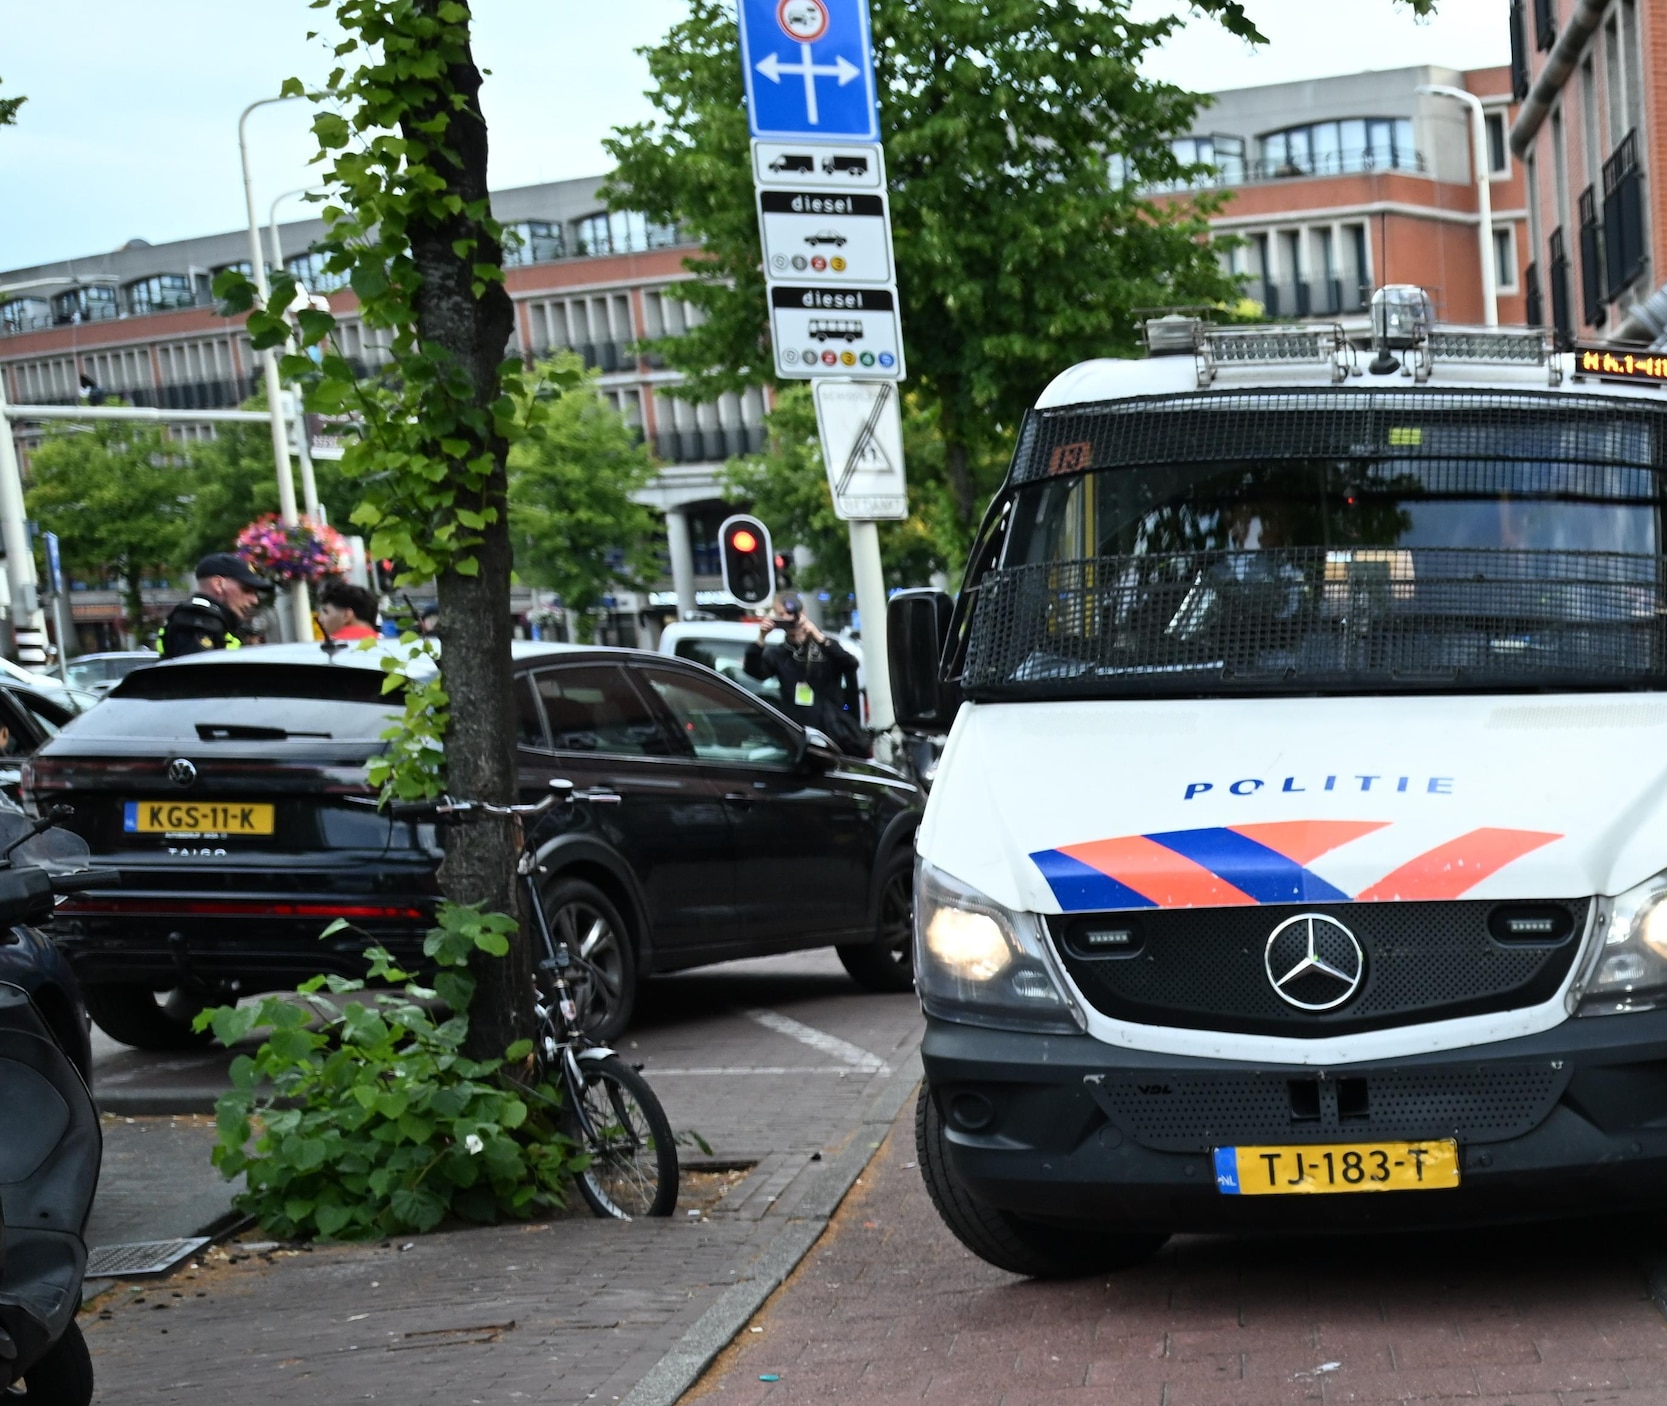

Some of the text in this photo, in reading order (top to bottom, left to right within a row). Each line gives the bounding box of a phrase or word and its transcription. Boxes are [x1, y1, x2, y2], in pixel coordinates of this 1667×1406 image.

[791, 195, 853, 213] diesel
[802, 290, 863, 308] diesel
[1184, 775, 1454, 800] POLITIE
[150, 806, 255, 829] KGS-11-K
[1221, 1148, 1429, 1187] NL TJ-183-T
